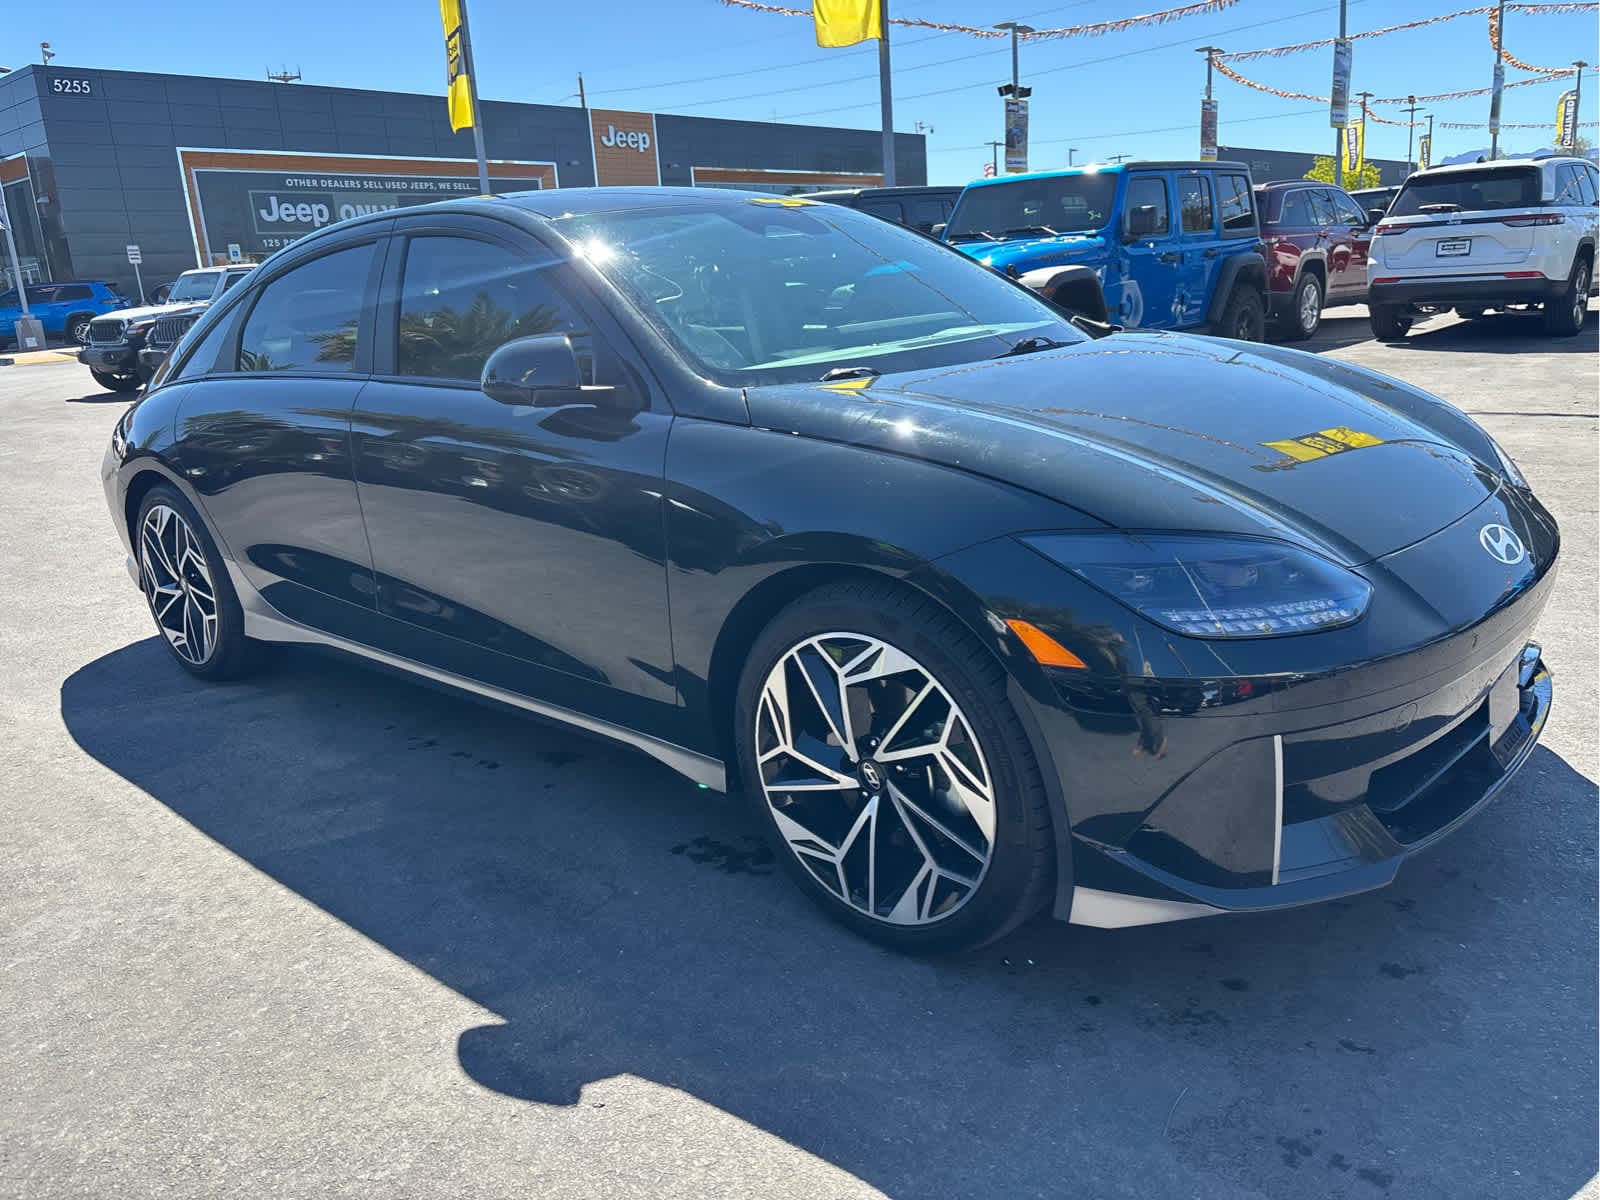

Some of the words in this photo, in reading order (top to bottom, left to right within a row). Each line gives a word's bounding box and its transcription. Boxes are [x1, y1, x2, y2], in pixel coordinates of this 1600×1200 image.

[53, 79, 91, 94] 5255
[601, 124, 651, 153] Jeep
[285, 178, 319, 188] OTHER
[320, 179, 361, 189] DEALERS
[363, 180, 383, 189] SELL
[385, 181, 408, 190] USED
[410, 182, 437, 191] JEEPS,
[438, 182, 451, 190] WE
[259, 196, 330, 228] Jeep
[339, 203, 397, 220] ON
[263, 239, 281, 248] 125
